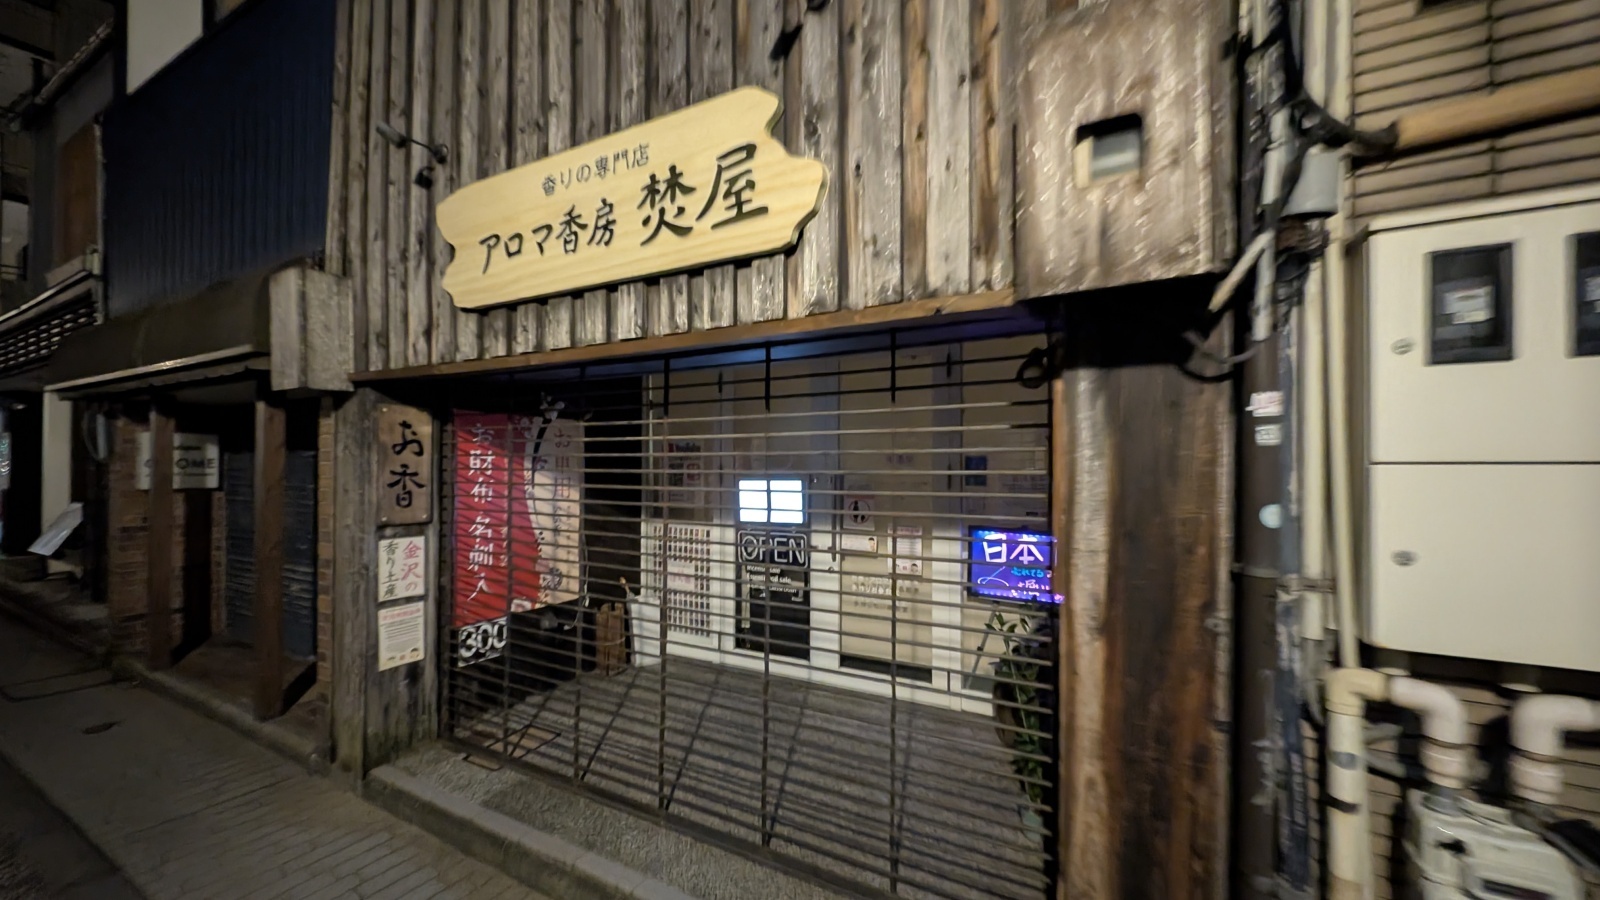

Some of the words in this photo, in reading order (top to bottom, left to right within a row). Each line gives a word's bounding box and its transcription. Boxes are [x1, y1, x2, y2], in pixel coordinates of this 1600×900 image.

[541, 143, 650, 197] 香りの専門店
[636, 143, 769, 247] 焚屋
[386, 420, 426, 509] お香
[382, 541, 399, 599] 香り土産
[401, 540, 422, 592] 金沢の
[741, 535, 805, 564] OPEN
[982, 533, 1045, 565] 日本
[458, 620, 508, 658] 300
